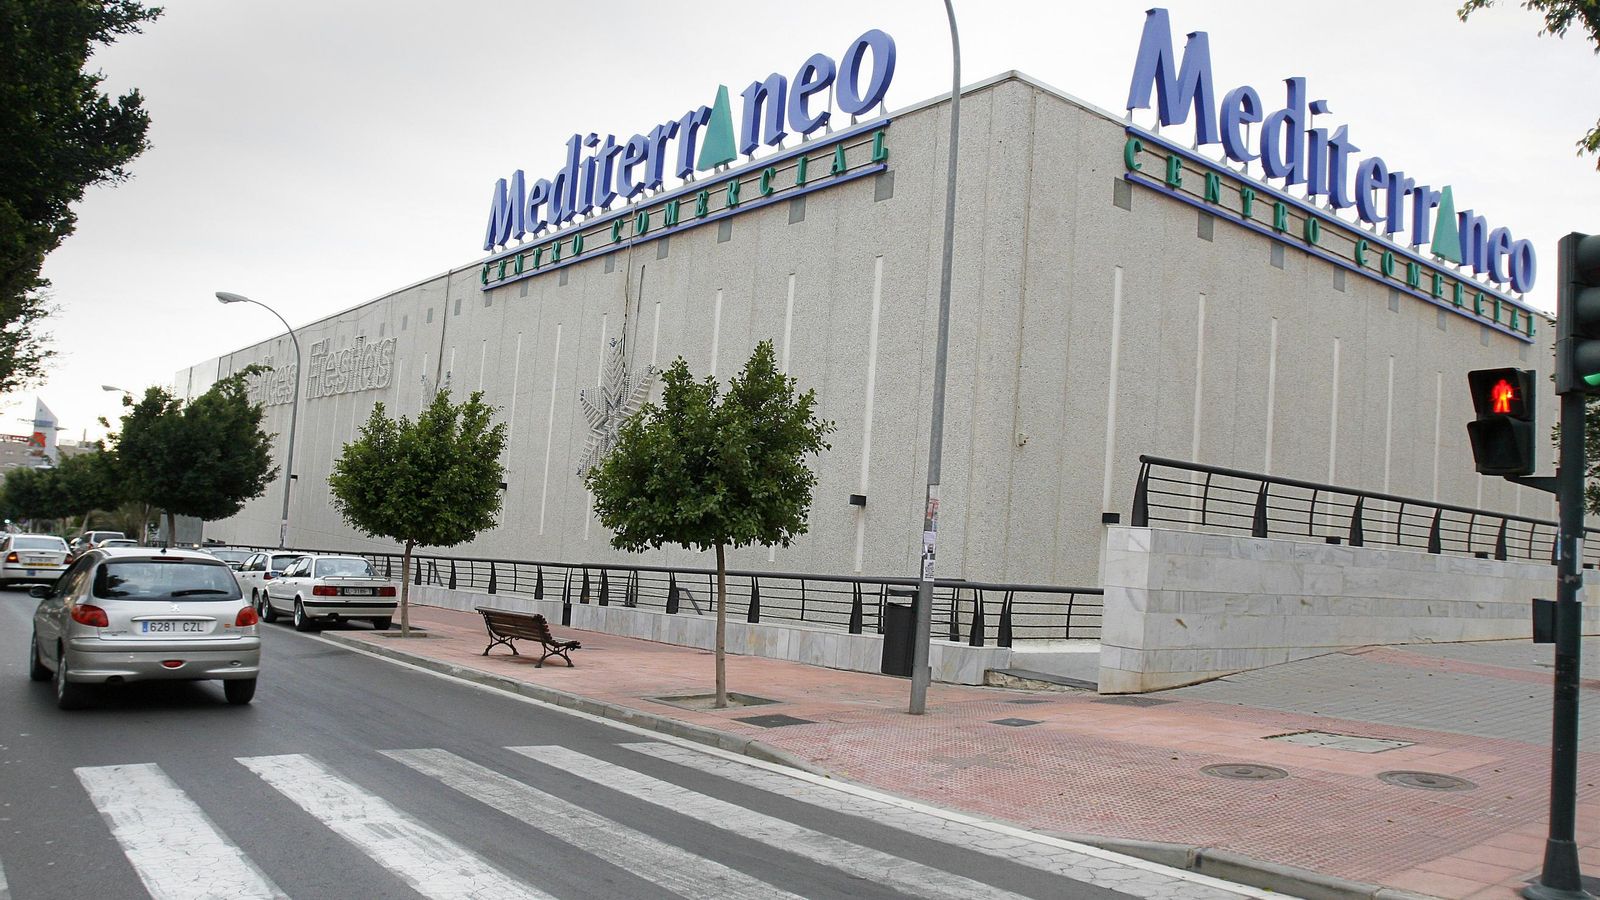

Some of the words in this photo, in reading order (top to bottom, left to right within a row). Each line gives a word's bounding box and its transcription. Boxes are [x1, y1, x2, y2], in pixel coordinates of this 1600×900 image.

[480, 232, 584, 285] CENTRO
[611, 130, 889, 243] COMERCIAL
[1124, 137, 1321, 246] CENTRO
[1355, 239, 1537, 337] COMERCIAL
[306, 336, 398, 400] Fiestas
[150, 622, 176, 632] 6281
[183, 622, 204, 632] CZL
